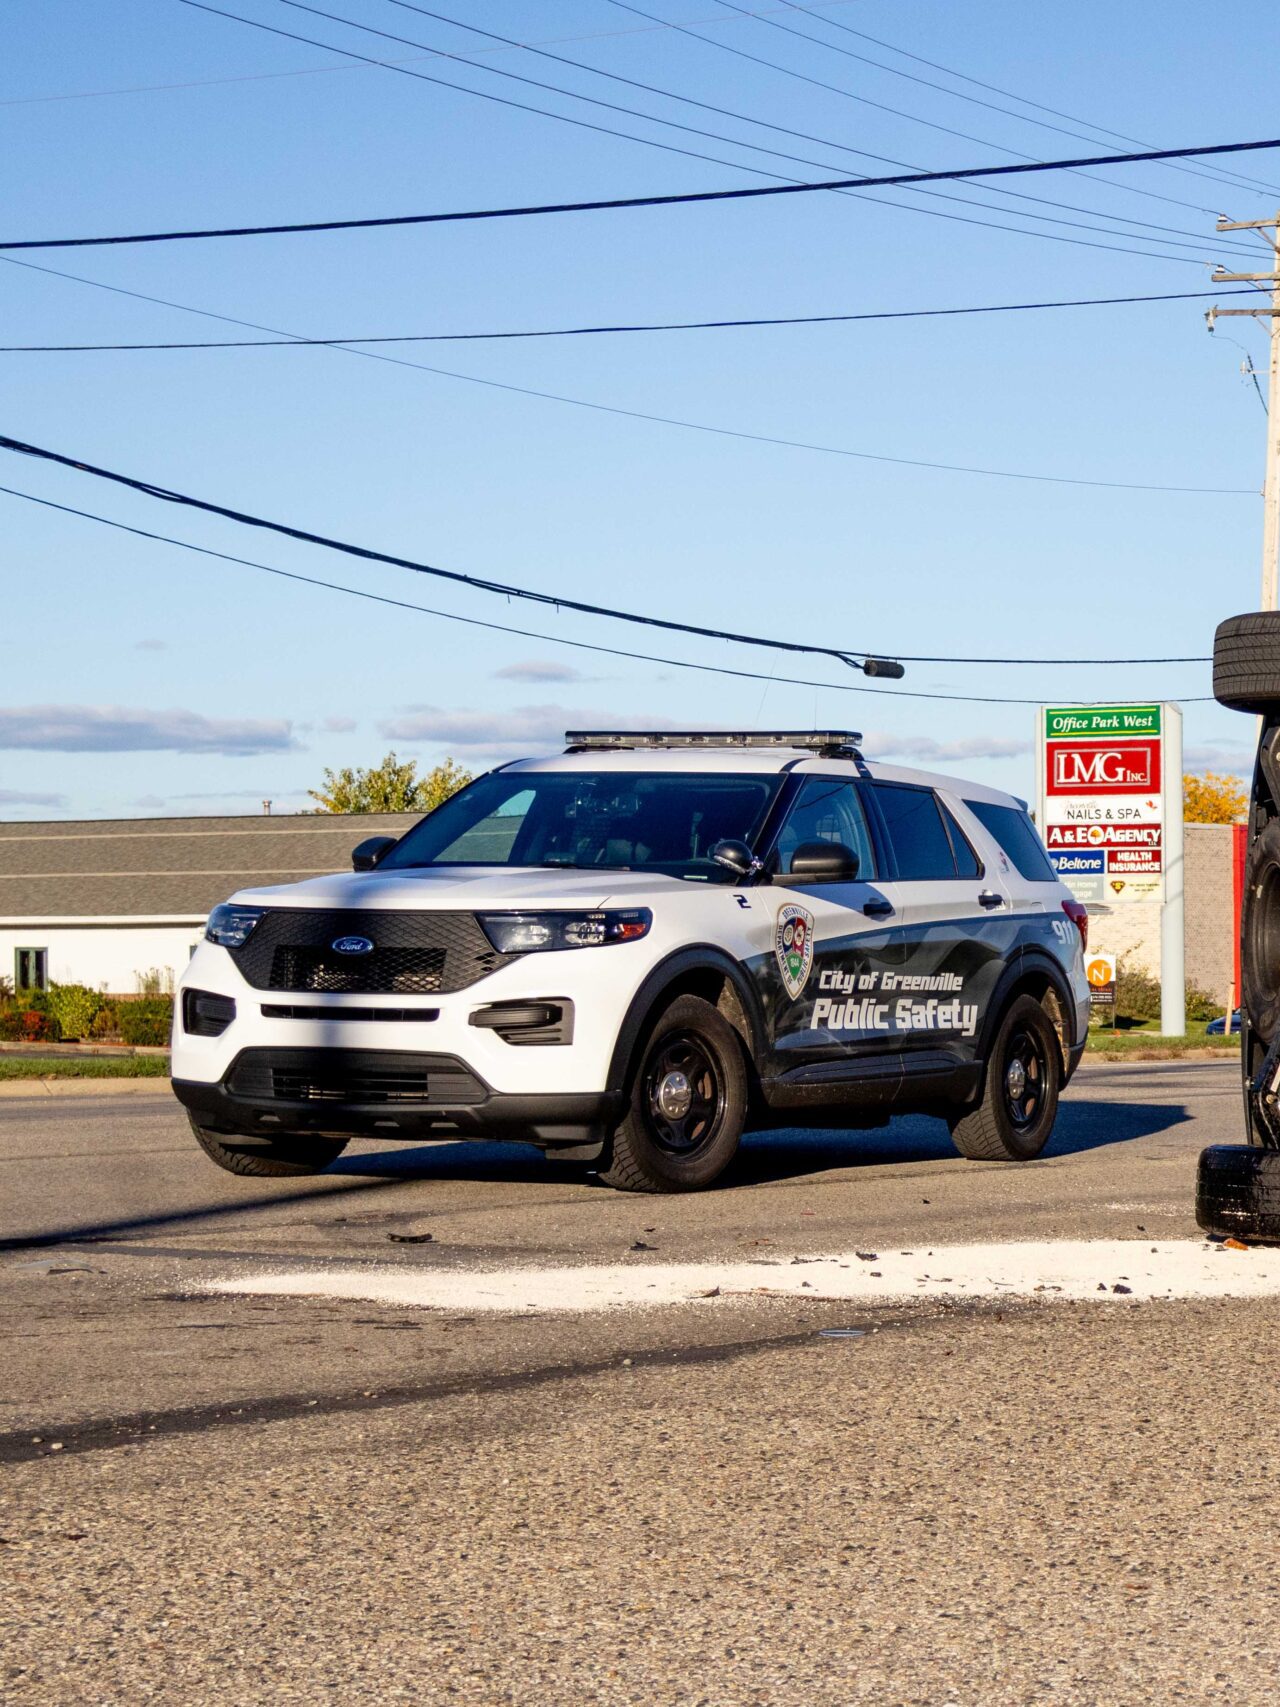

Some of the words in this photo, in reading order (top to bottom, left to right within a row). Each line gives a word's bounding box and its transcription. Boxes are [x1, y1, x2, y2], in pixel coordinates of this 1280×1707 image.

[1053, 717, 1088, 732] Office
[1091, 715, 1119, 728] Park
[1123, 715, 1153, 727] West
[1057, 752, 1125, 783] LMG
[1067, 809, 1101, 820] NAILS
[1105, 808, 1114, 819] &
[1117, 808, 1142, 819] SPA
[1058, 856, 1101, 870] Beltone
[1117, 852, 1152, 861] HEALTH
[1109, 862, 1161, 871] INSURANCE
[733, 895, 752, 908] 2
[1051, 920, 1074, 944] 911
[340, 940, 363, 950] Ford
[819, 970, 855, 994] City
[858, 971, 879, 990] of
[880, 971, 963, 991] Greenville
[810, 998, 890, 1029] Public
[895, 998, 979, 1037] Safety
